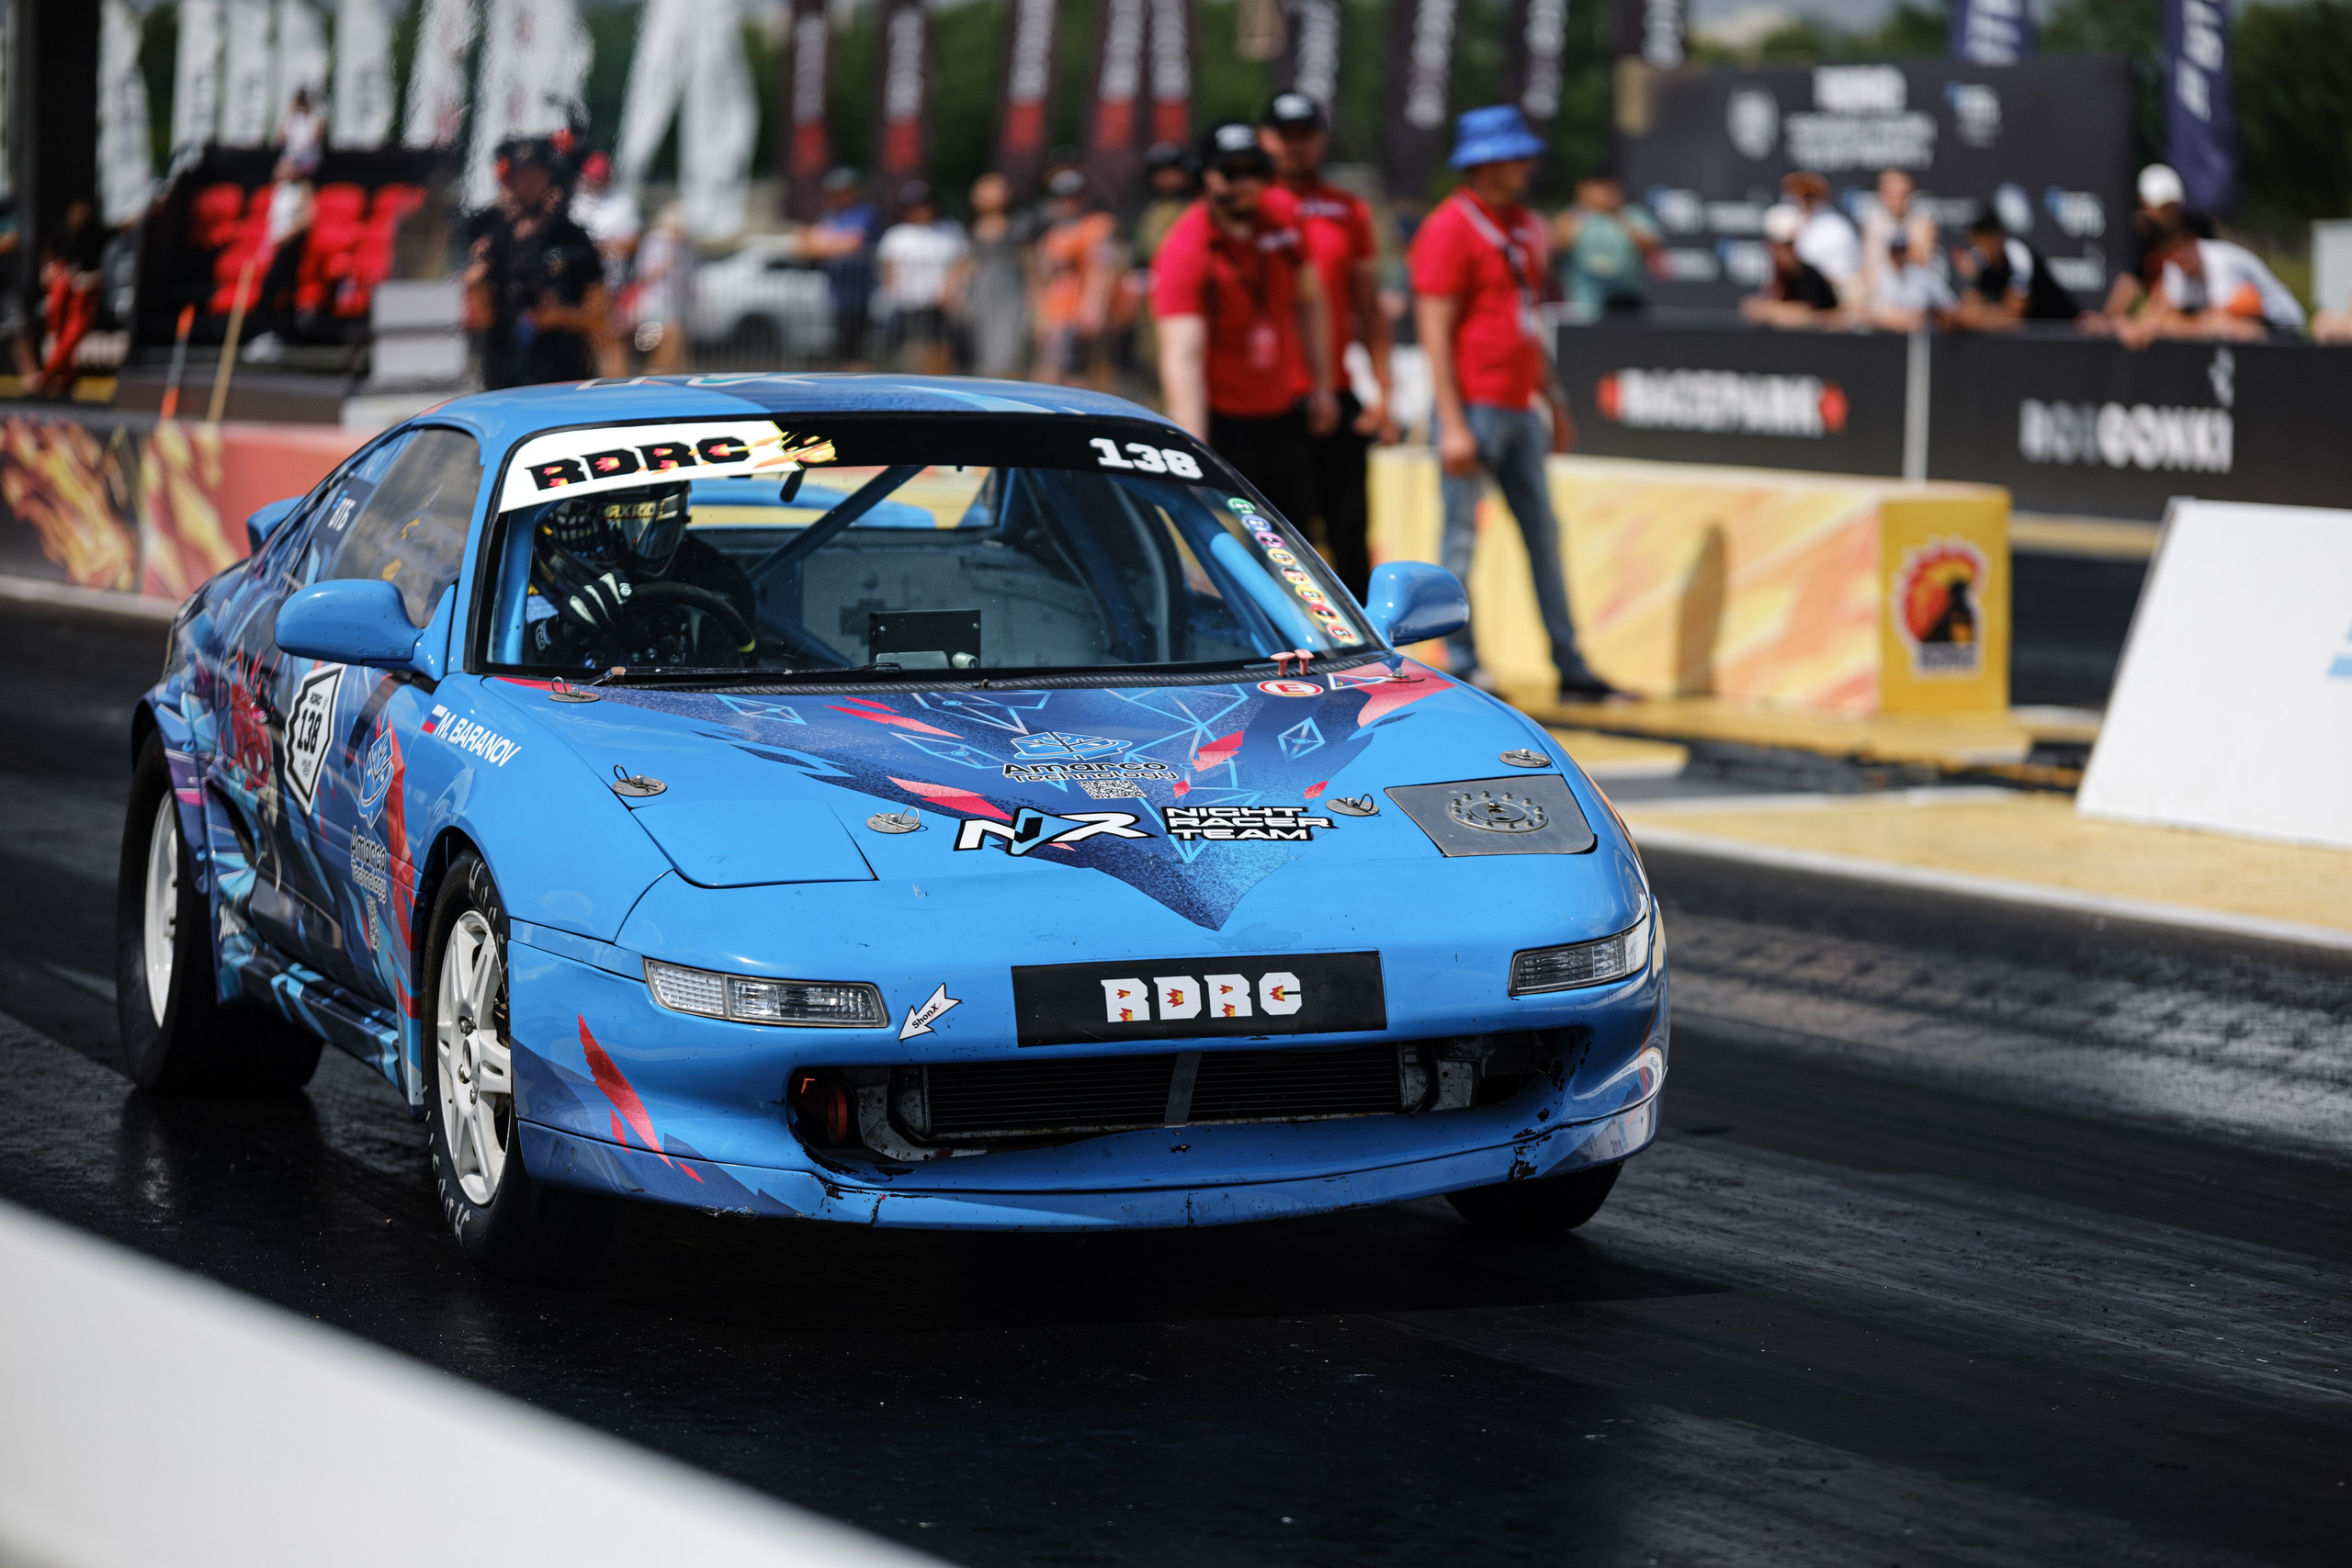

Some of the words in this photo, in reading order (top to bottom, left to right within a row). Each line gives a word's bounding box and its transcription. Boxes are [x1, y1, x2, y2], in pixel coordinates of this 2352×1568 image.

[525, 436, 751, 491] RDRC
[1089, 437, 1204, 479] 138
[297, 707, 322, 763] 138
[434, 711, 458, 740] M.
[447, 717, 522, 768] BARANOV
[1002, 761, 1169, 776] Amarco
[1006, 771, 1180, 783] Technology
[1166, 807, 1304, 817] NIGHT
[1168, 817, 1330, 828] RACER
[351, 824, 386, 874] Amarco
[1170, 829, 1308, 840] TEAM
[351, 859, 387, 904] Technology
[911, 1002, 939, 1029] ShonX
[1100, 971, 1303, 1023] RDRC
